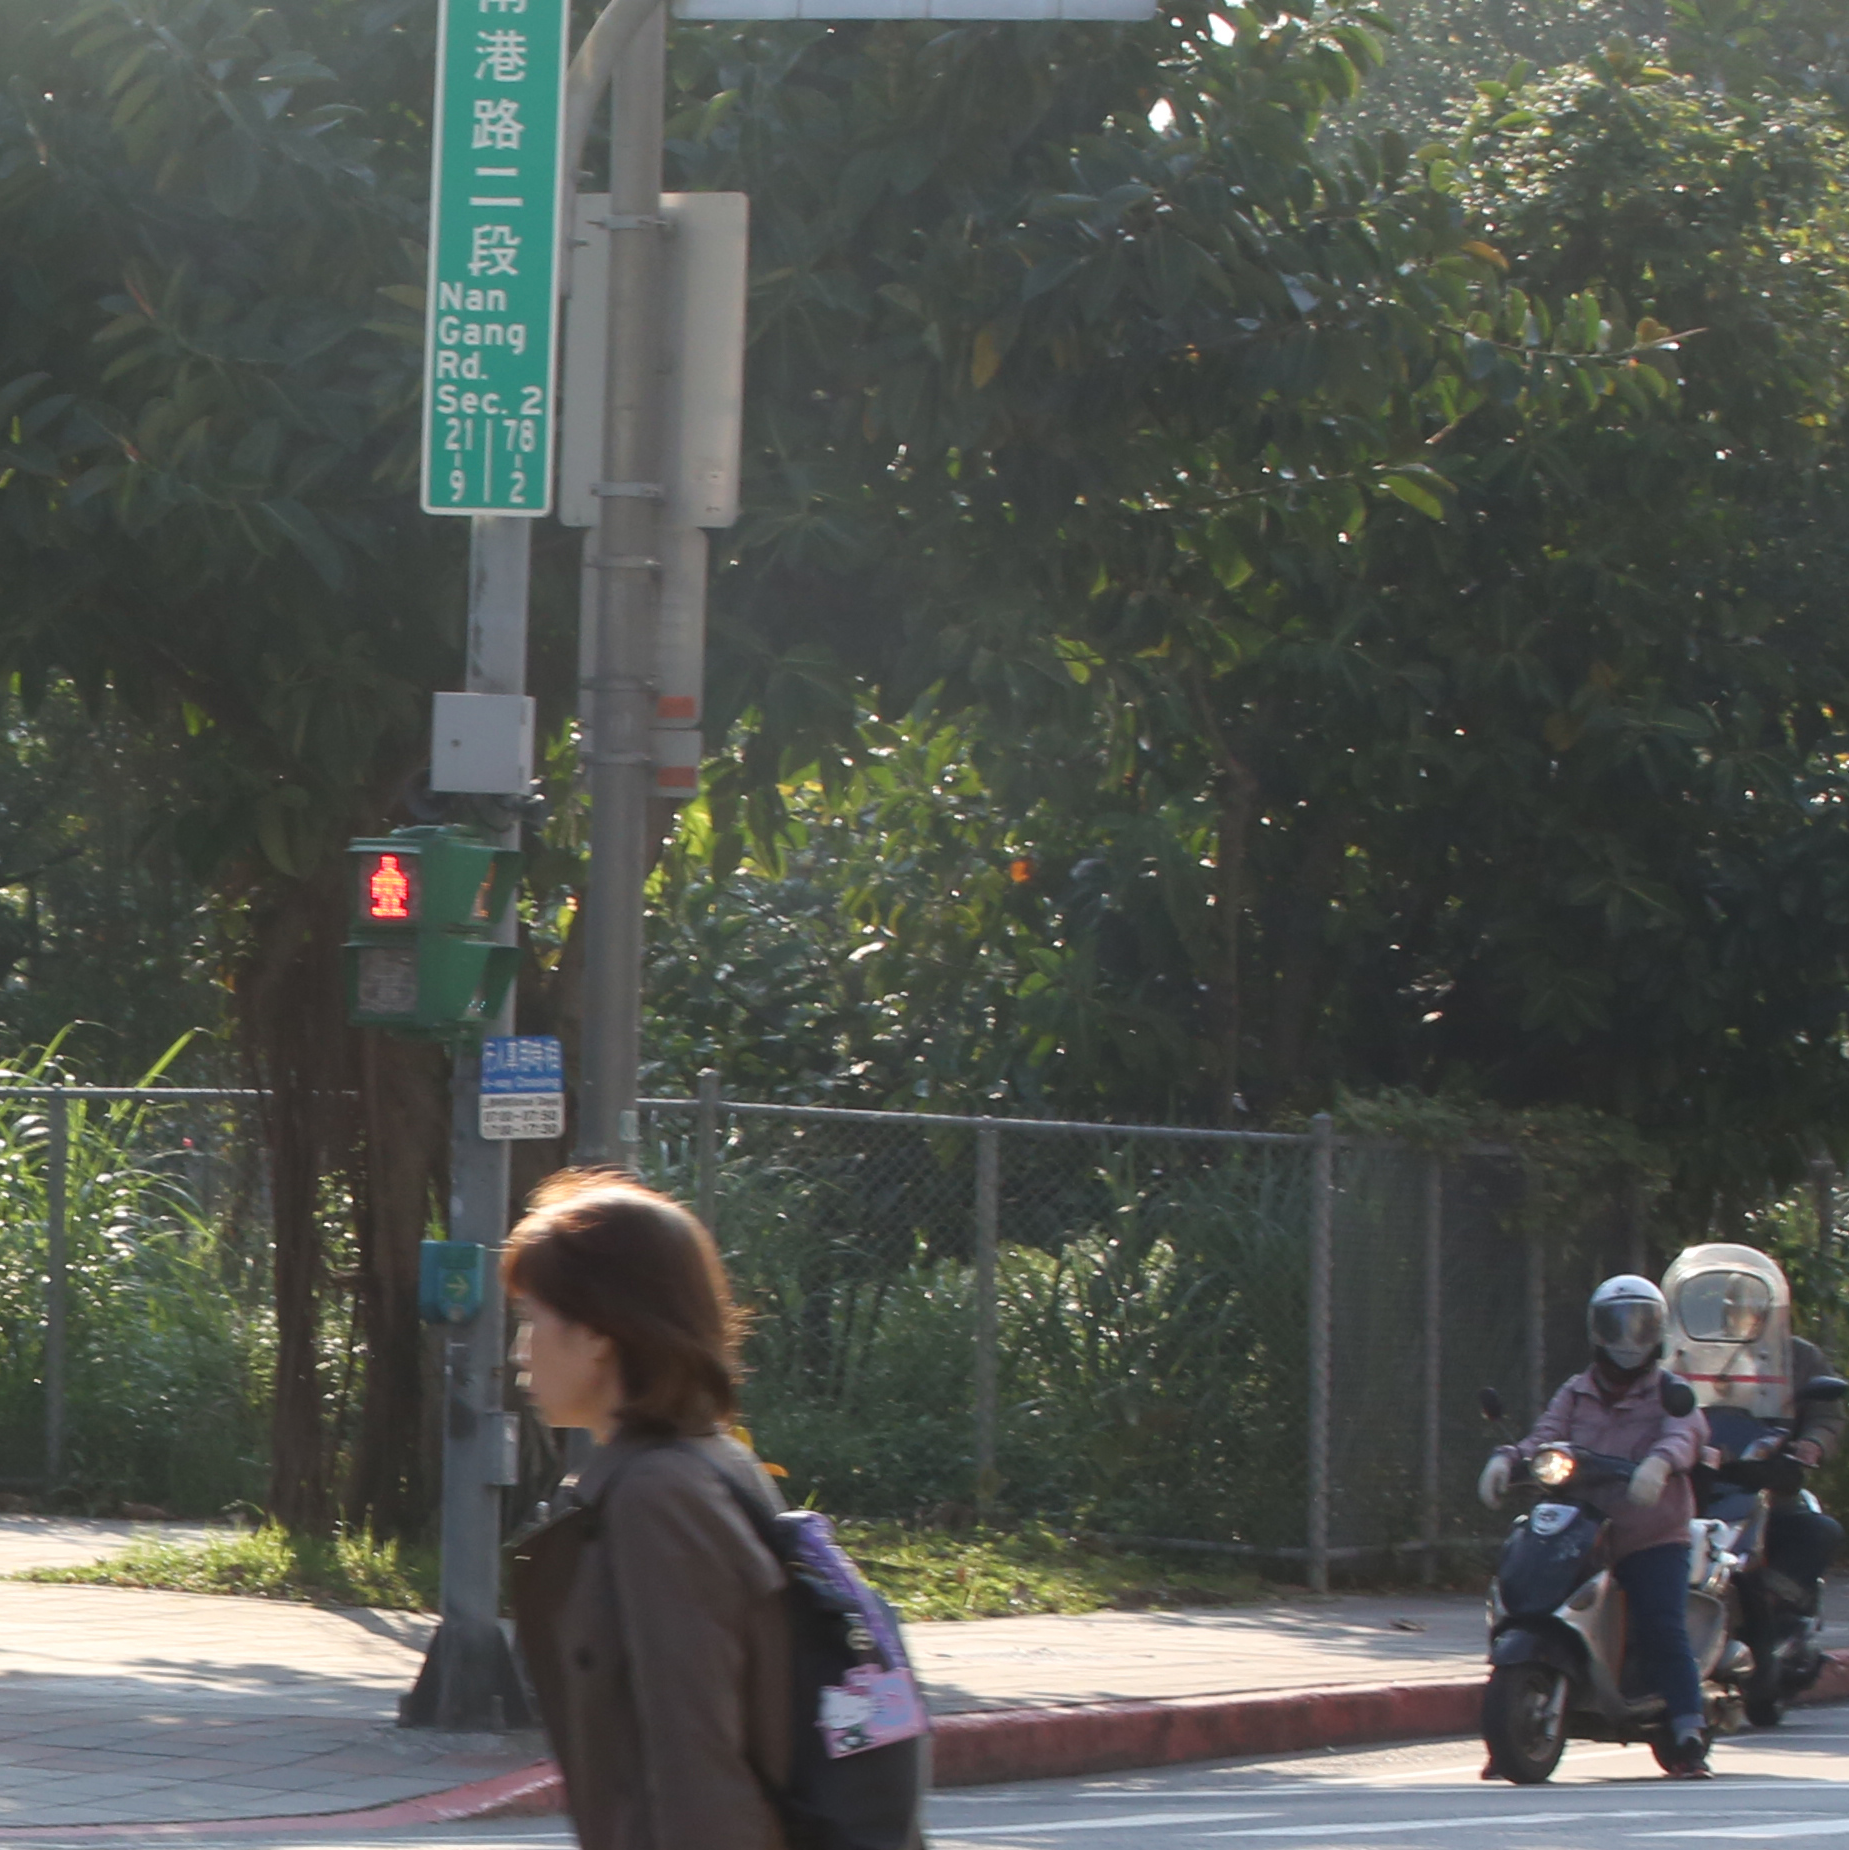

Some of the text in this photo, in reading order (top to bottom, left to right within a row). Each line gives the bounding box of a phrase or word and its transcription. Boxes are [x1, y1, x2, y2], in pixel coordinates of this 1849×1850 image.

[437, 281, 507, 312] Nan
[436, 315, 527, 356] Gang
[436, 349, 488, 380] Rd.
[436, 384, 543, 416] Sec. 2
[444, 417, 474, 451] 21
[502, 418, 537, 453] 78
